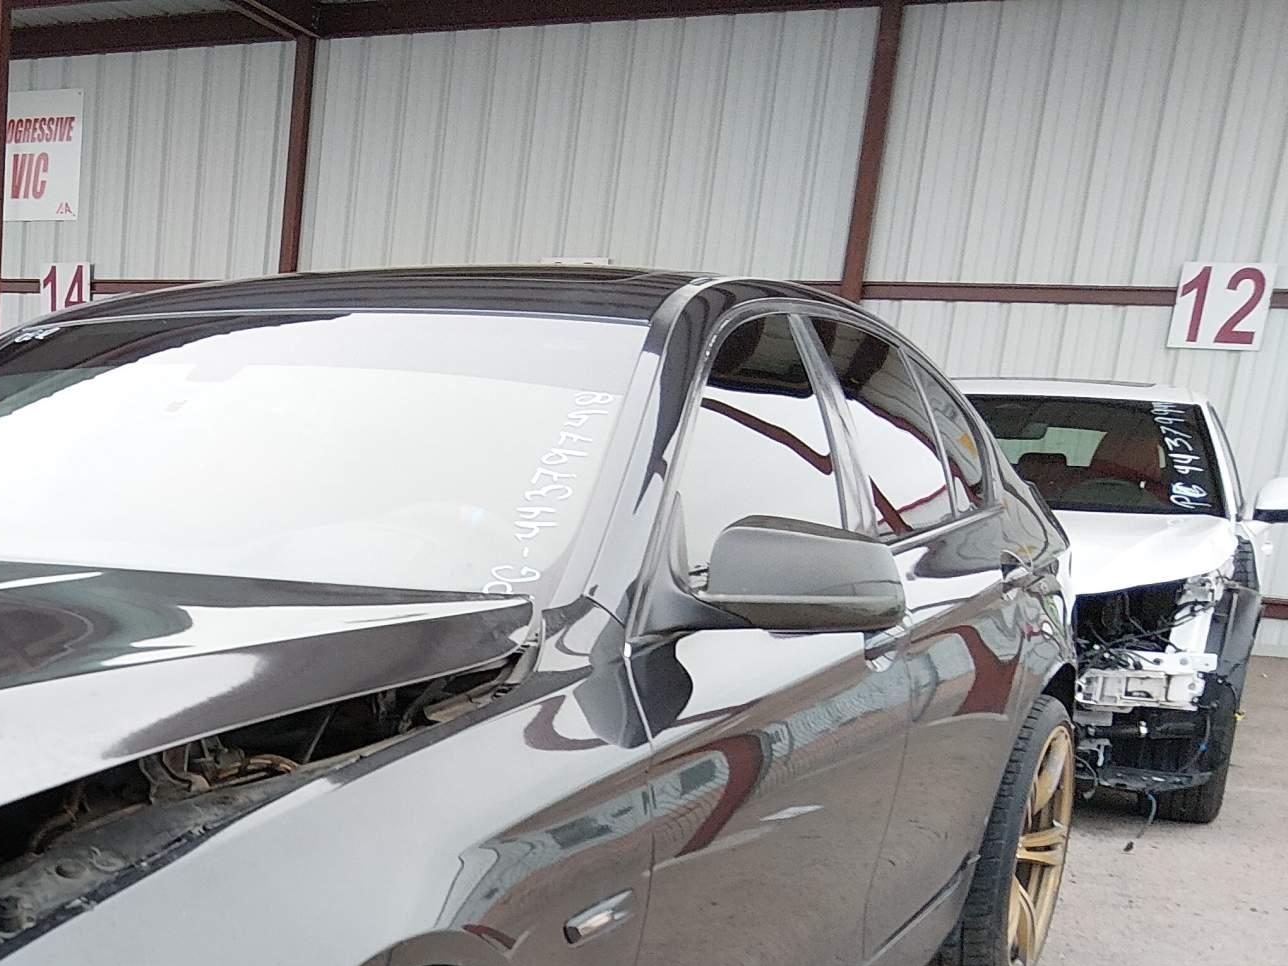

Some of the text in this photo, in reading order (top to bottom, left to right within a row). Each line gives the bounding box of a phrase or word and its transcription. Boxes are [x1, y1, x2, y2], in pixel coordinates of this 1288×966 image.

[7, 116, 76, 144] OGRESSIVE
[11, 152, 49, 199] VIC
[43, 264, 87, 312] 14
[1179, 266, 1266, 344] 12
